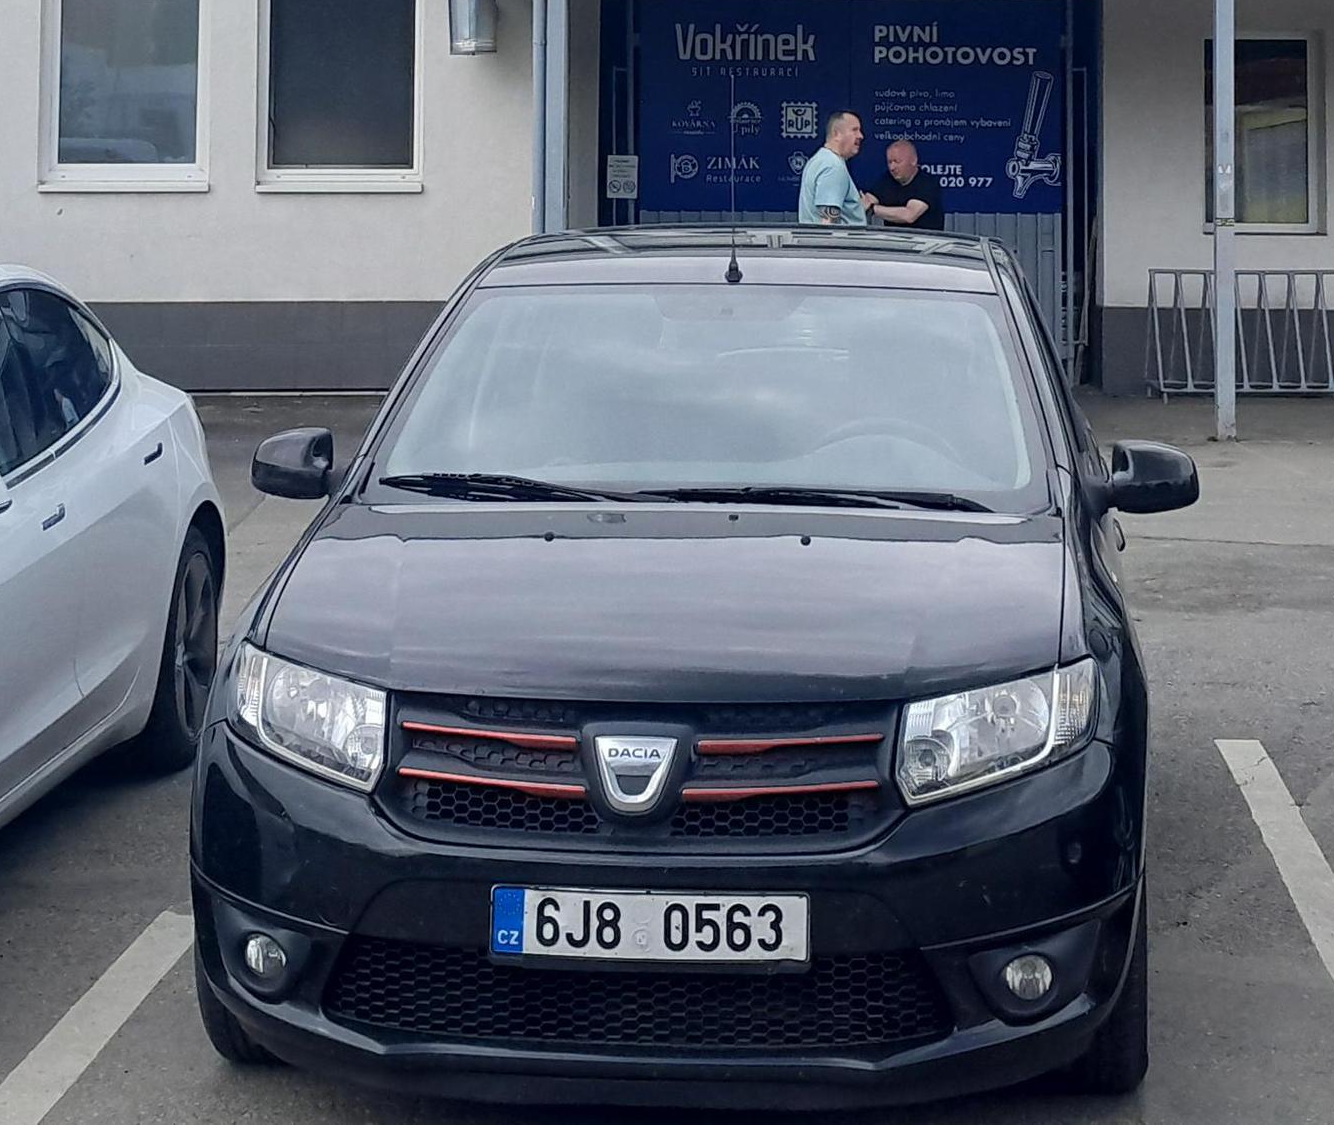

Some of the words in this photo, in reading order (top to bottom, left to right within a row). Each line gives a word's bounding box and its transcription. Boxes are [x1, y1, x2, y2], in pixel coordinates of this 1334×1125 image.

[874, 22, 939, 43] PIVNÍ
[675, 24, 816, 62] Vokřínek
[874, 46, 1038, 65] POHOTOVOST
[918, 102, 958, 113] chlazení
[874, 117, 912, 129] catering
[970, 117, 1012, 129] vybavení
[943, 133, 965, 144] ceny
[706, 155, 760, 169] ZIMÁK
[920, 164, 963, 176] OLEJTE
[706, 174, 761, 183] Restaurace
[939, 177, 965, 187] 020
[968, 177, 993, 188] 977
[608, 748, 662, 760] DACIA
[535, 897, 622, 951] 6J8
[663, 902, 784, 953] 0563
[497, 930, 520, 946] CZ
